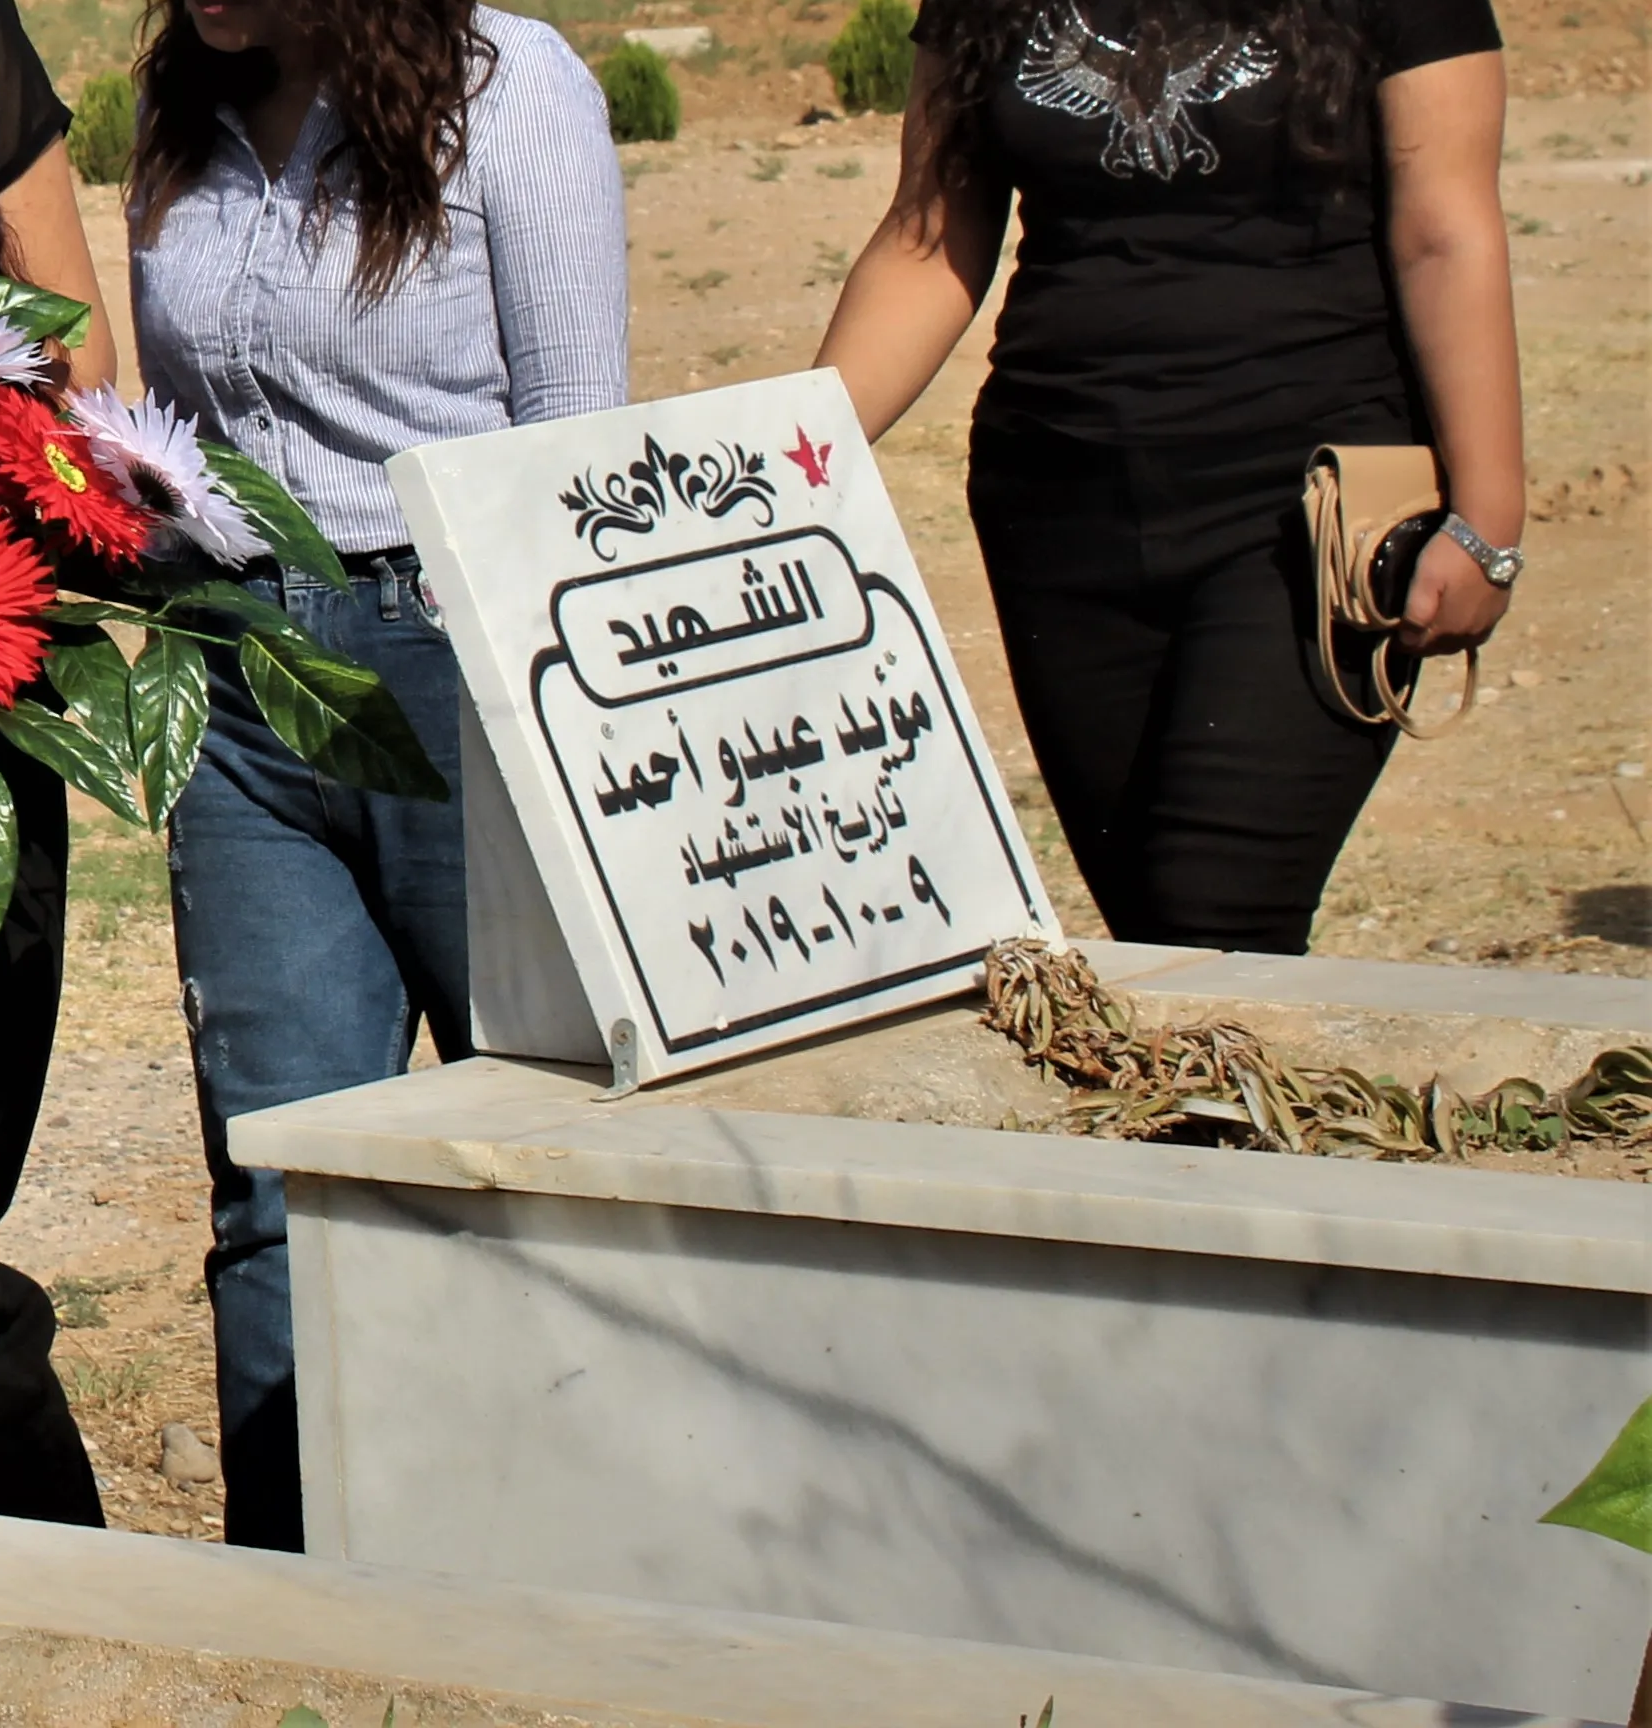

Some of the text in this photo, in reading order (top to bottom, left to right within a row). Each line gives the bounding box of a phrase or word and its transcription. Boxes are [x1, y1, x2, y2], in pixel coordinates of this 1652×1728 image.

[608, 558, 825, 678] الشهيد
[594, 664, 933, 817] مؤيد عبدو أحمد
[680, 775, 908, 889] تاريخ الاستشهاد
